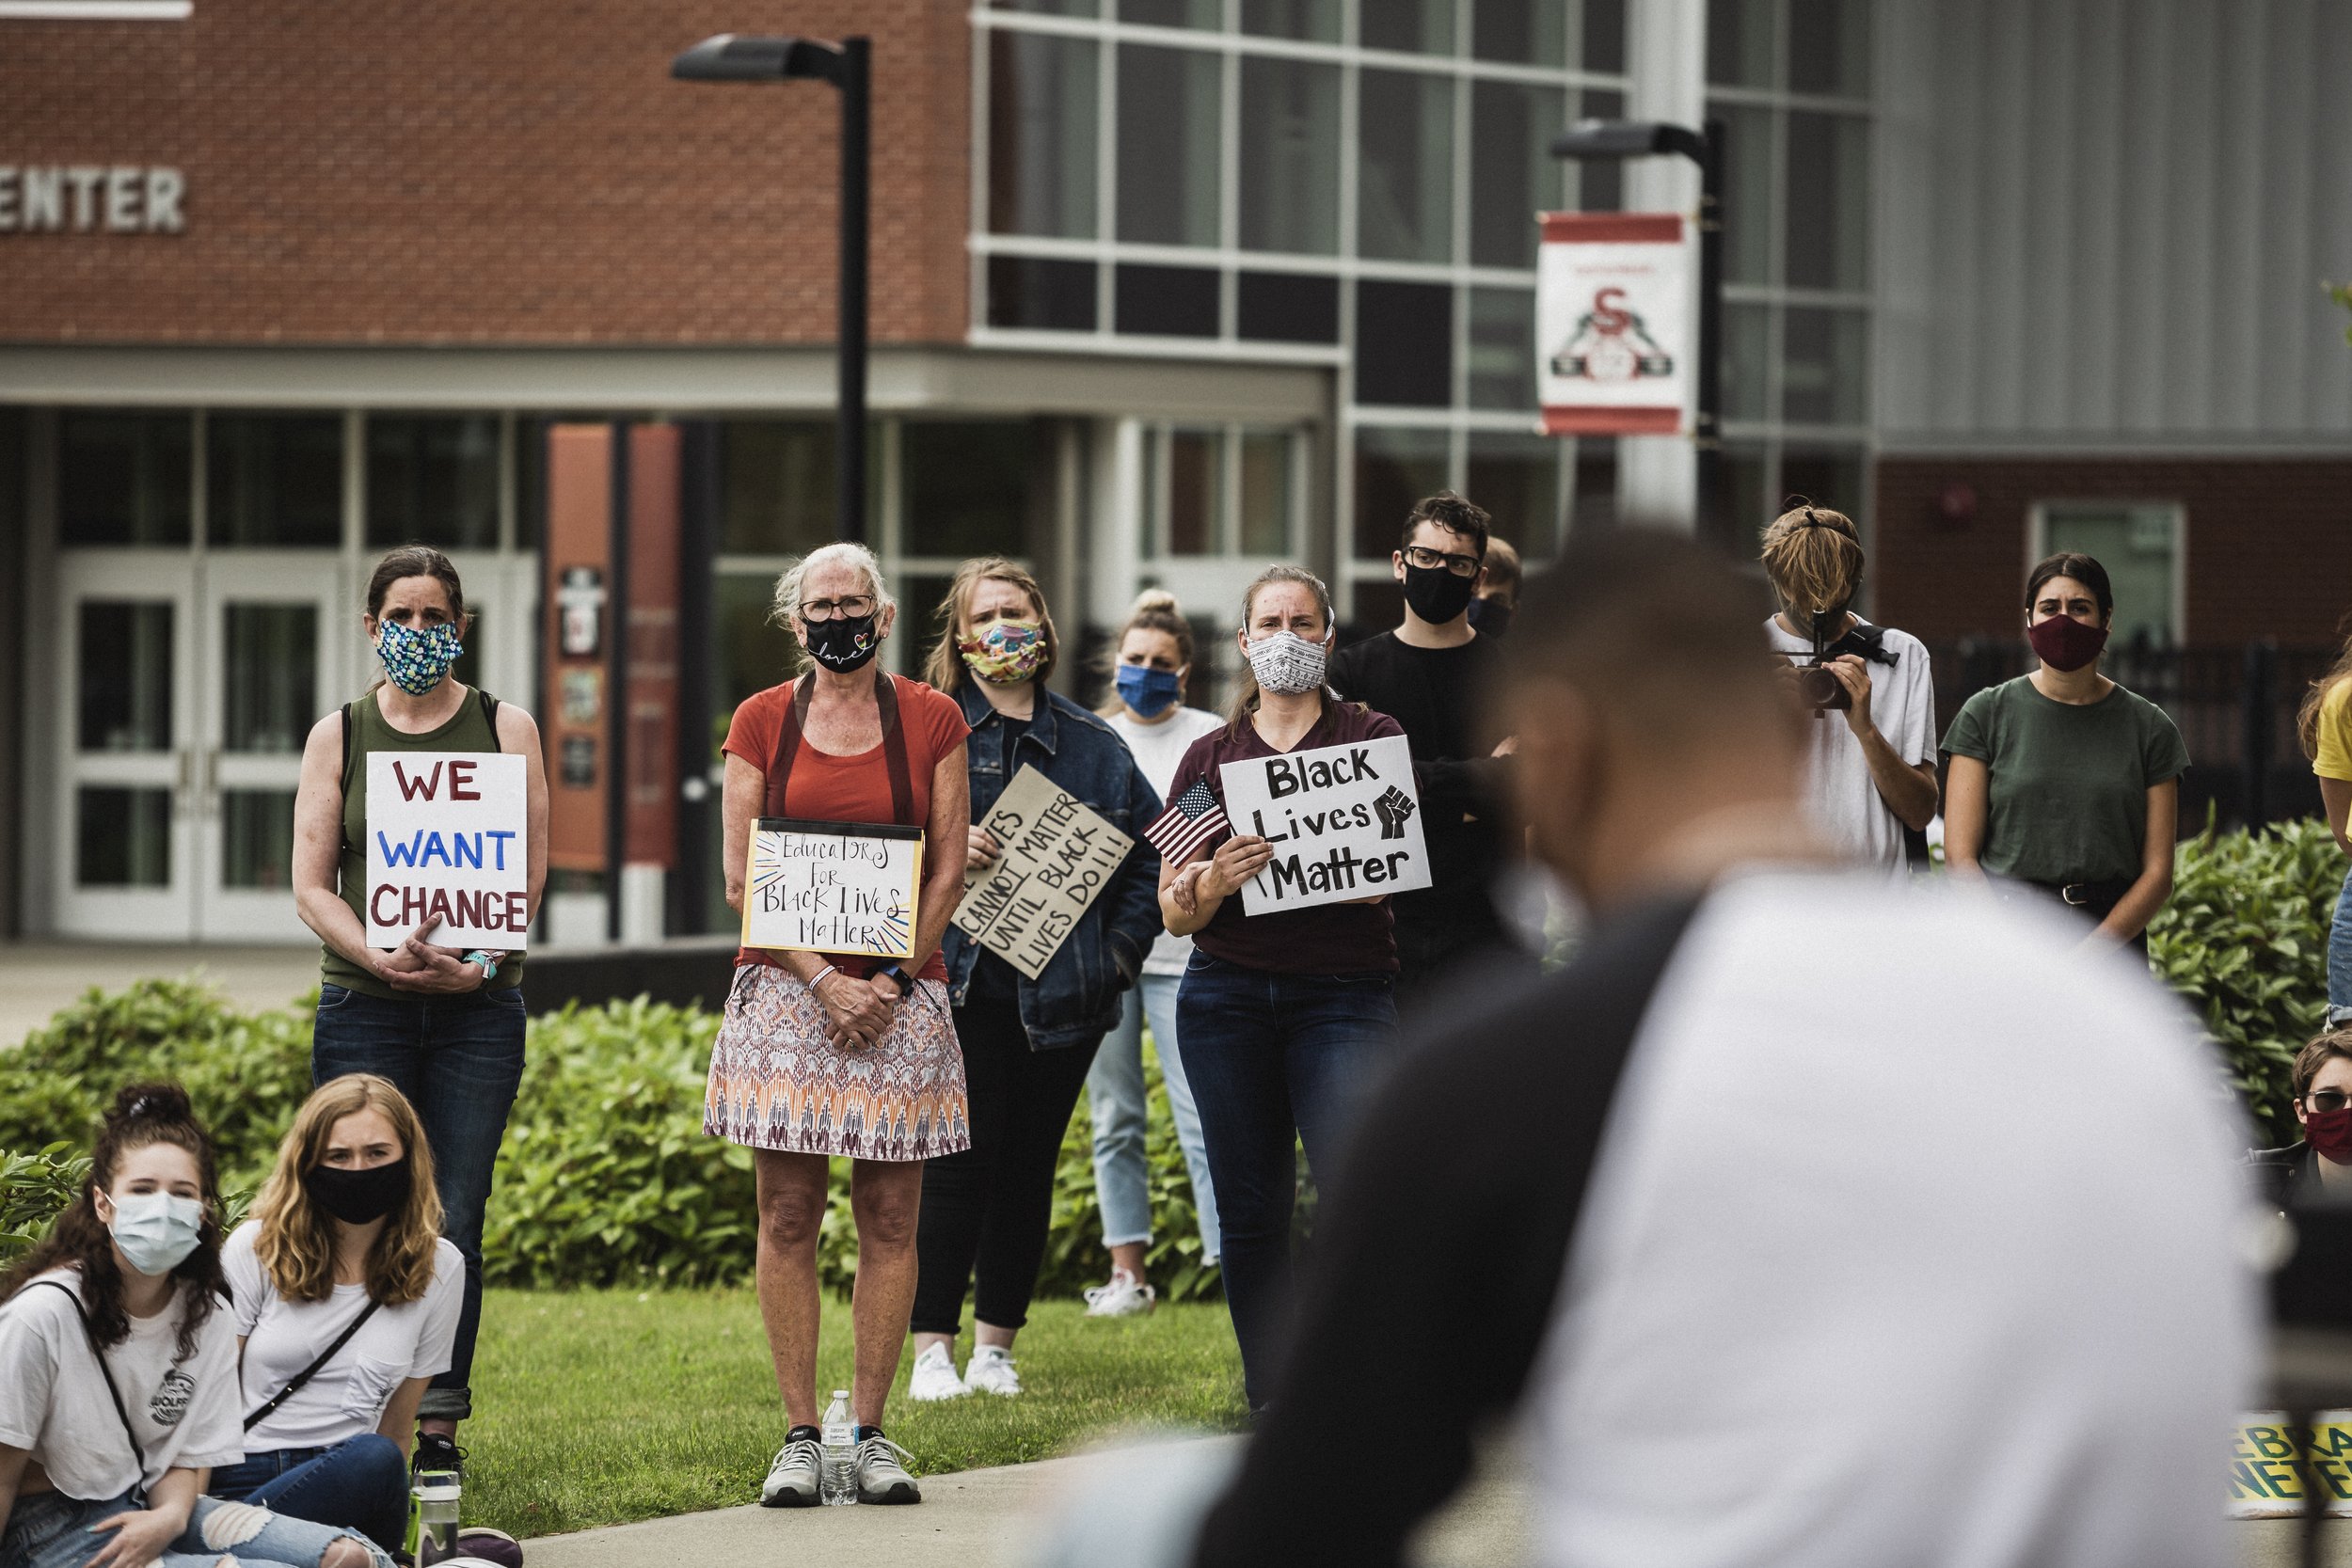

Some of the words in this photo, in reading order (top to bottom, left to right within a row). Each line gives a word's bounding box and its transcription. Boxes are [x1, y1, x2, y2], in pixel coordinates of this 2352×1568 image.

[813, 641, 865, 665] love
[392, 760, 482, 801] WE
[984, 810, 1024, 849] VES
[1252, 803, 1371, 843] Lives
[376, 829, 516, 871] WANT
[960, 858, 1025, 934] CANNOT
[1016, 792, 1080, 863] MATTER
[988, 897, 1047, 952] UNTIL
[1037, 827, 1099, 890] BLACK
[1268, 847, 1409, 900] Matter
[370, 883, 528, 932] CHANGE
[1018, 910, 1073, 971] LIVES
